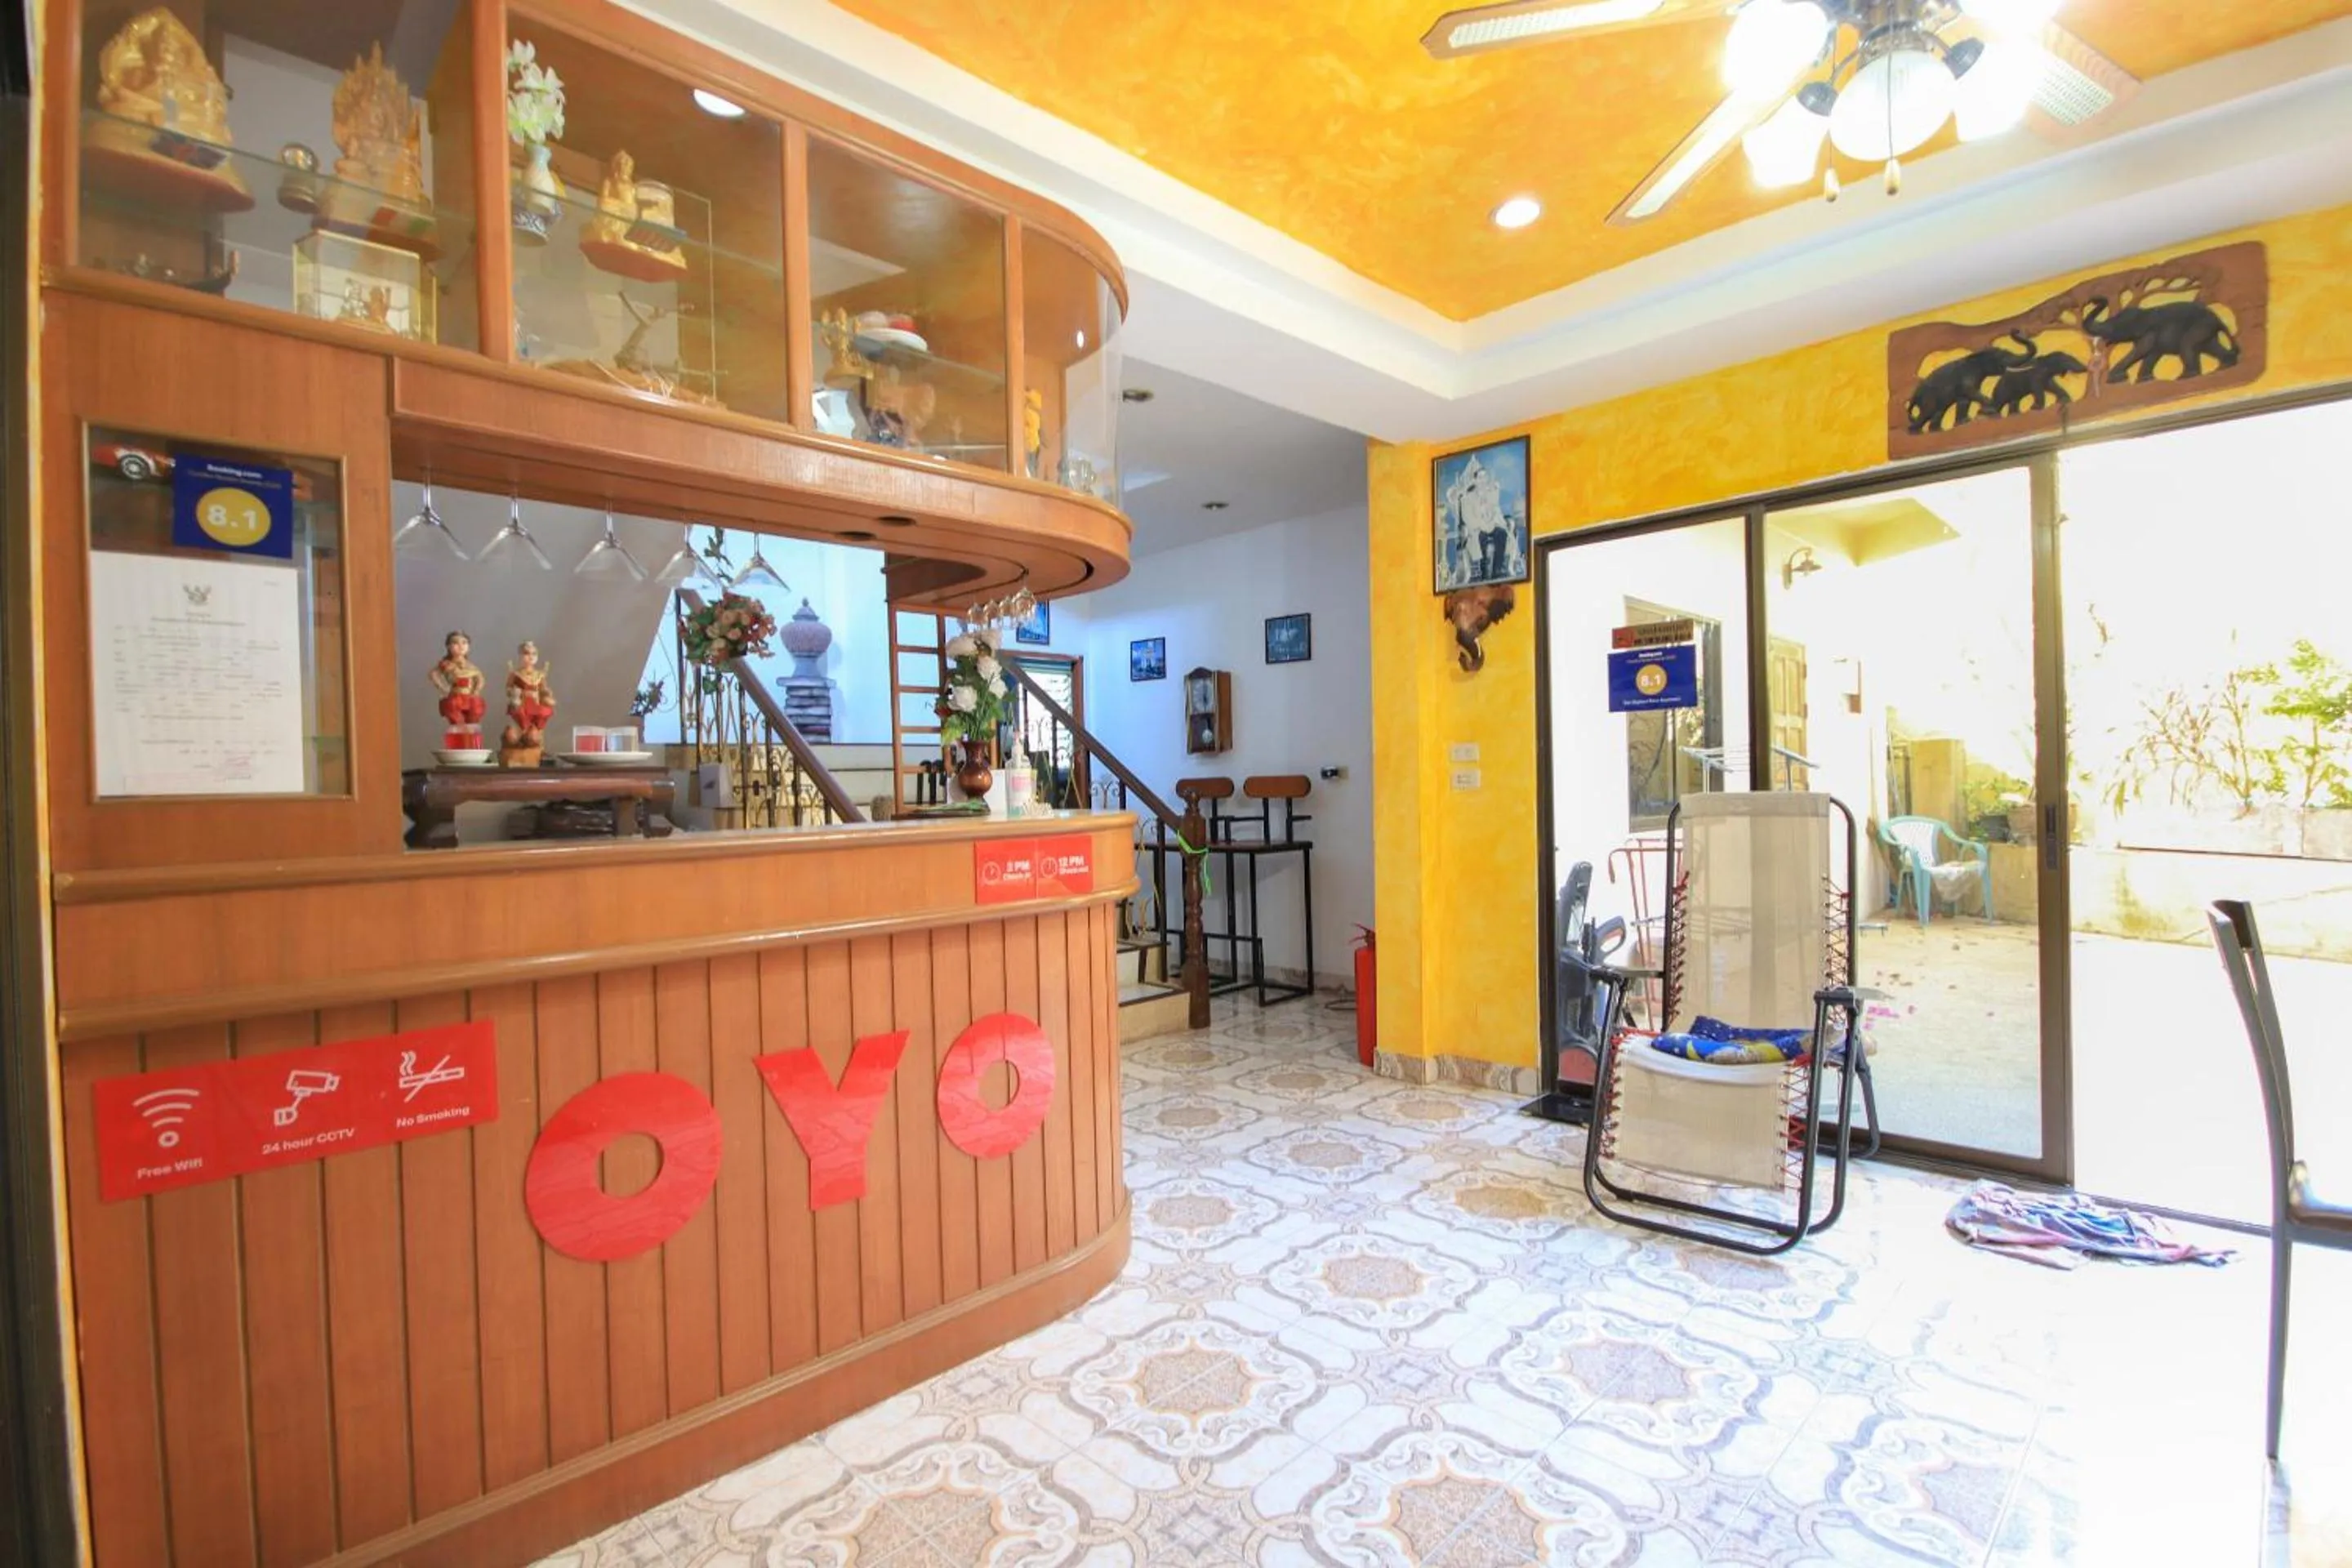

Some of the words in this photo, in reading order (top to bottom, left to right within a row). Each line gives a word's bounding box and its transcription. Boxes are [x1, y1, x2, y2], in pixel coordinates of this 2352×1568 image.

[207, 503, 258, 531] 8.1
[1641, 674, 1662, 687] 8.1
[1014, 860, 1030, 871] PM
[1069, 855, 1085, 866] PM
[396, 1116, 414, 1129] No
[416, 1106, 470, 1125] Smoking
[262, 1143, 280, 1155] 24
[282, 1137, 315, 1152] hour
[316, 1128, 355, 1143] CCTV
[525, 1013, 1055, 1263] OYO
[137, 1167, 172, 1180] Free
